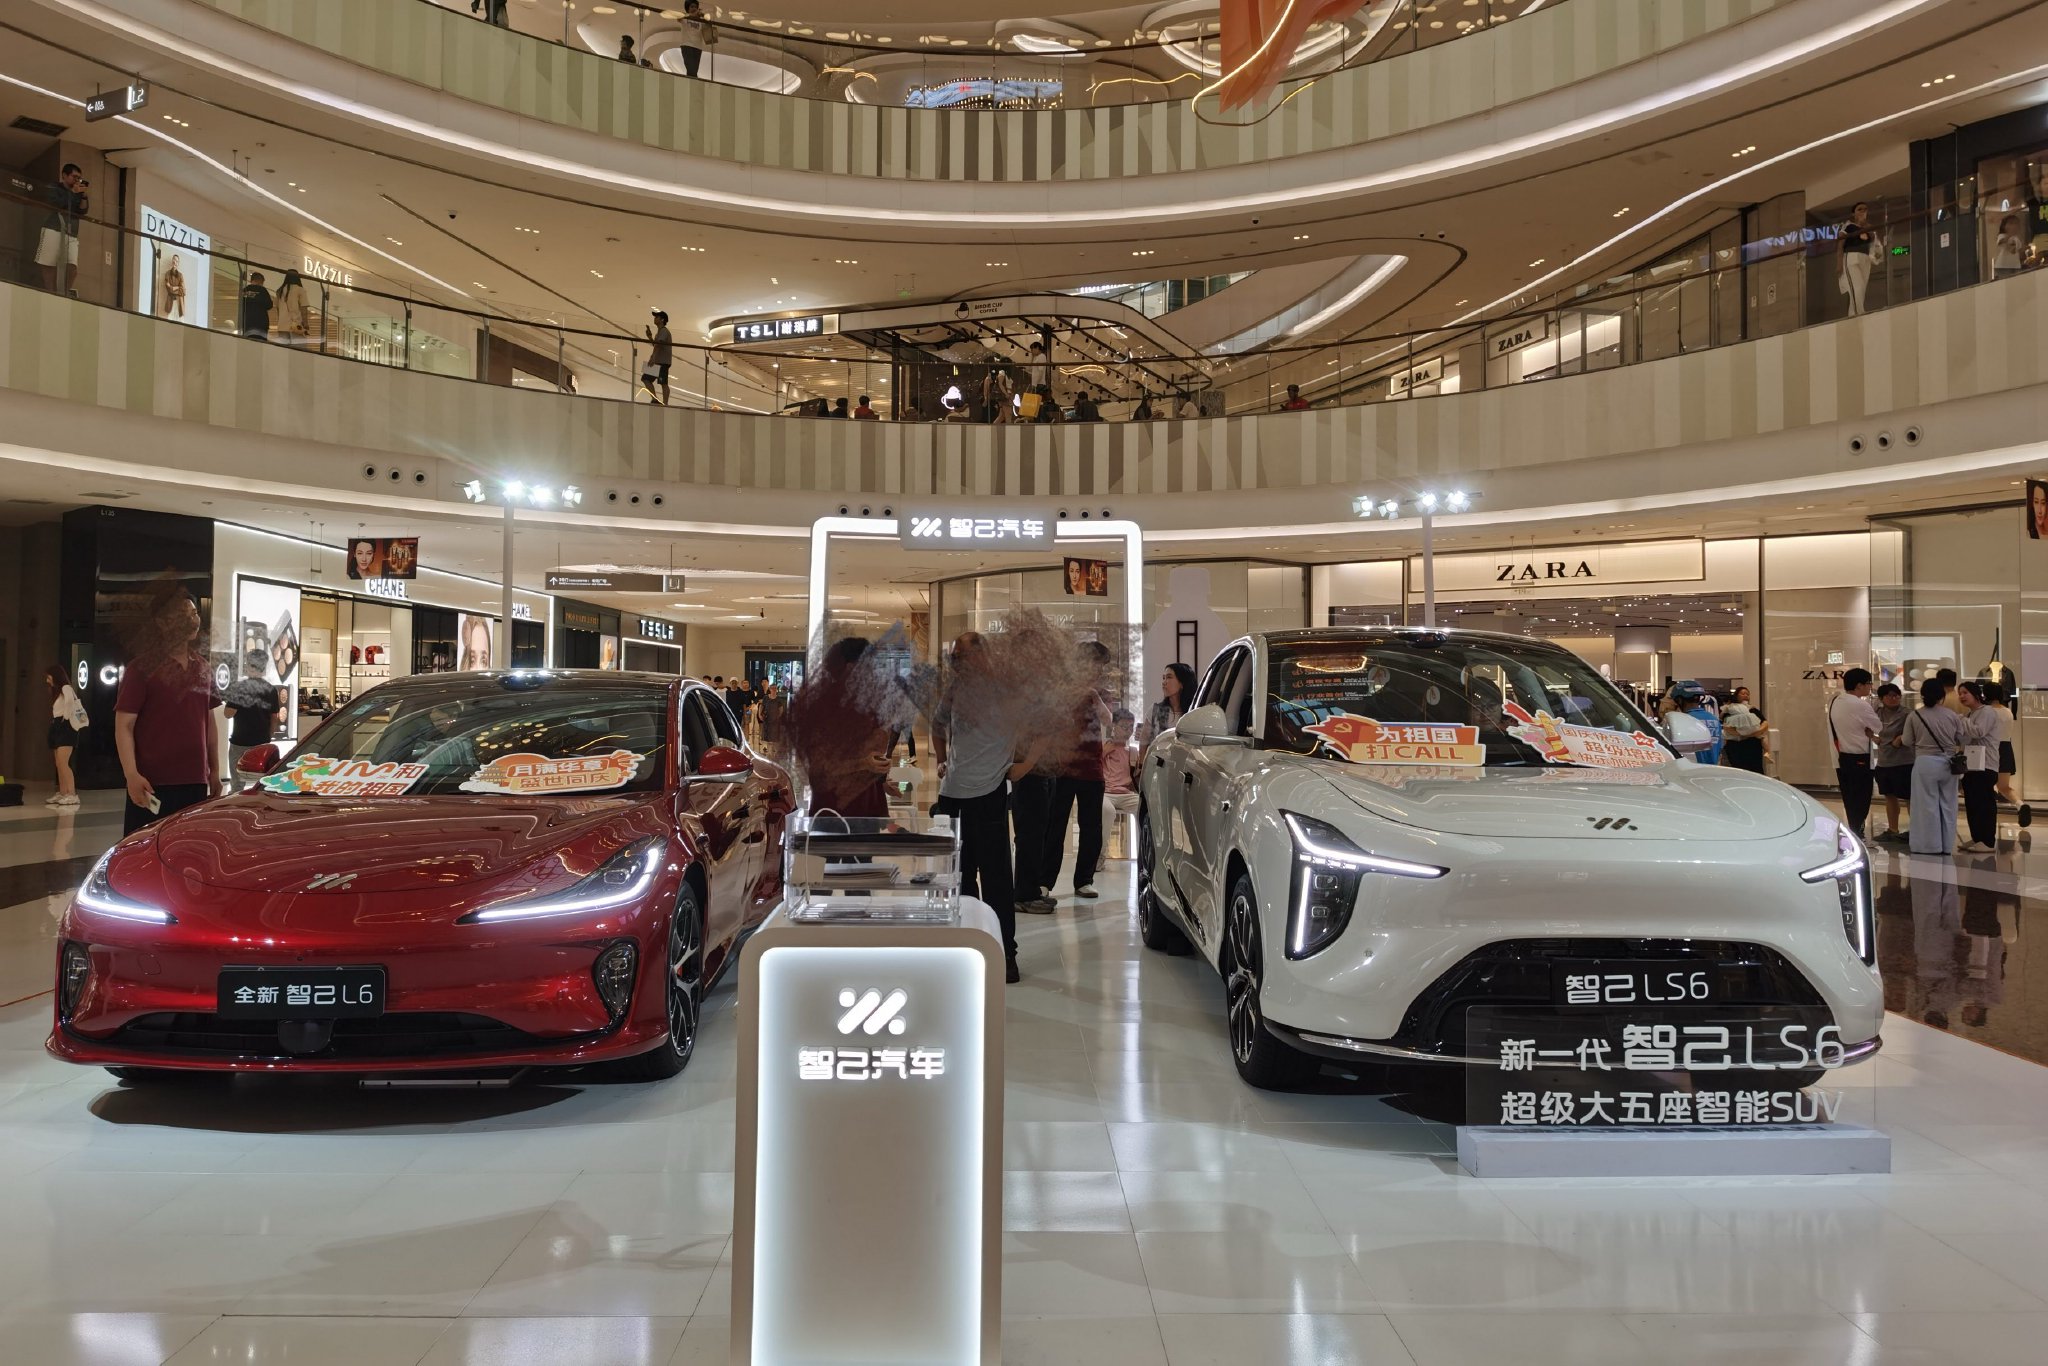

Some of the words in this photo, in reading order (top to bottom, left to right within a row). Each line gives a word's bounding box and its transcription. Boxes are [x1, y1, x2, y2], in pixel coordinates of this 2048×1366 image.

[304, 256, 353, 287] DAZZLE
[737, 325, 774, 339] TSL
[1499, 330, 1533, 352] ZARA
[949, 517, 1044, 539] 智己汽车
[1496, 560, 1597, 581] ZARA
[366, 579, 409, 599] CHANEL
[640, 619, 674, 640] TESLA
[1802, 670, 1845, 680] ZAR
[1375, 727, 1459, 744] 为祖国
[1366, 744, 1464, 760] 打CALL
[513, 759, 605, 776] 月满华章
[313, 781, 409, 796] 我的祖国
[519, 772, 611, 788] 盛世同庆
[234, 985, 280, 1004] 全新
[799, 1047, 945, 1080] 智己汽车
[1500, 1038, 1611, 1071] 新一代
[1500, 1090, 1844, 1125] 超级大五座智能SUV
